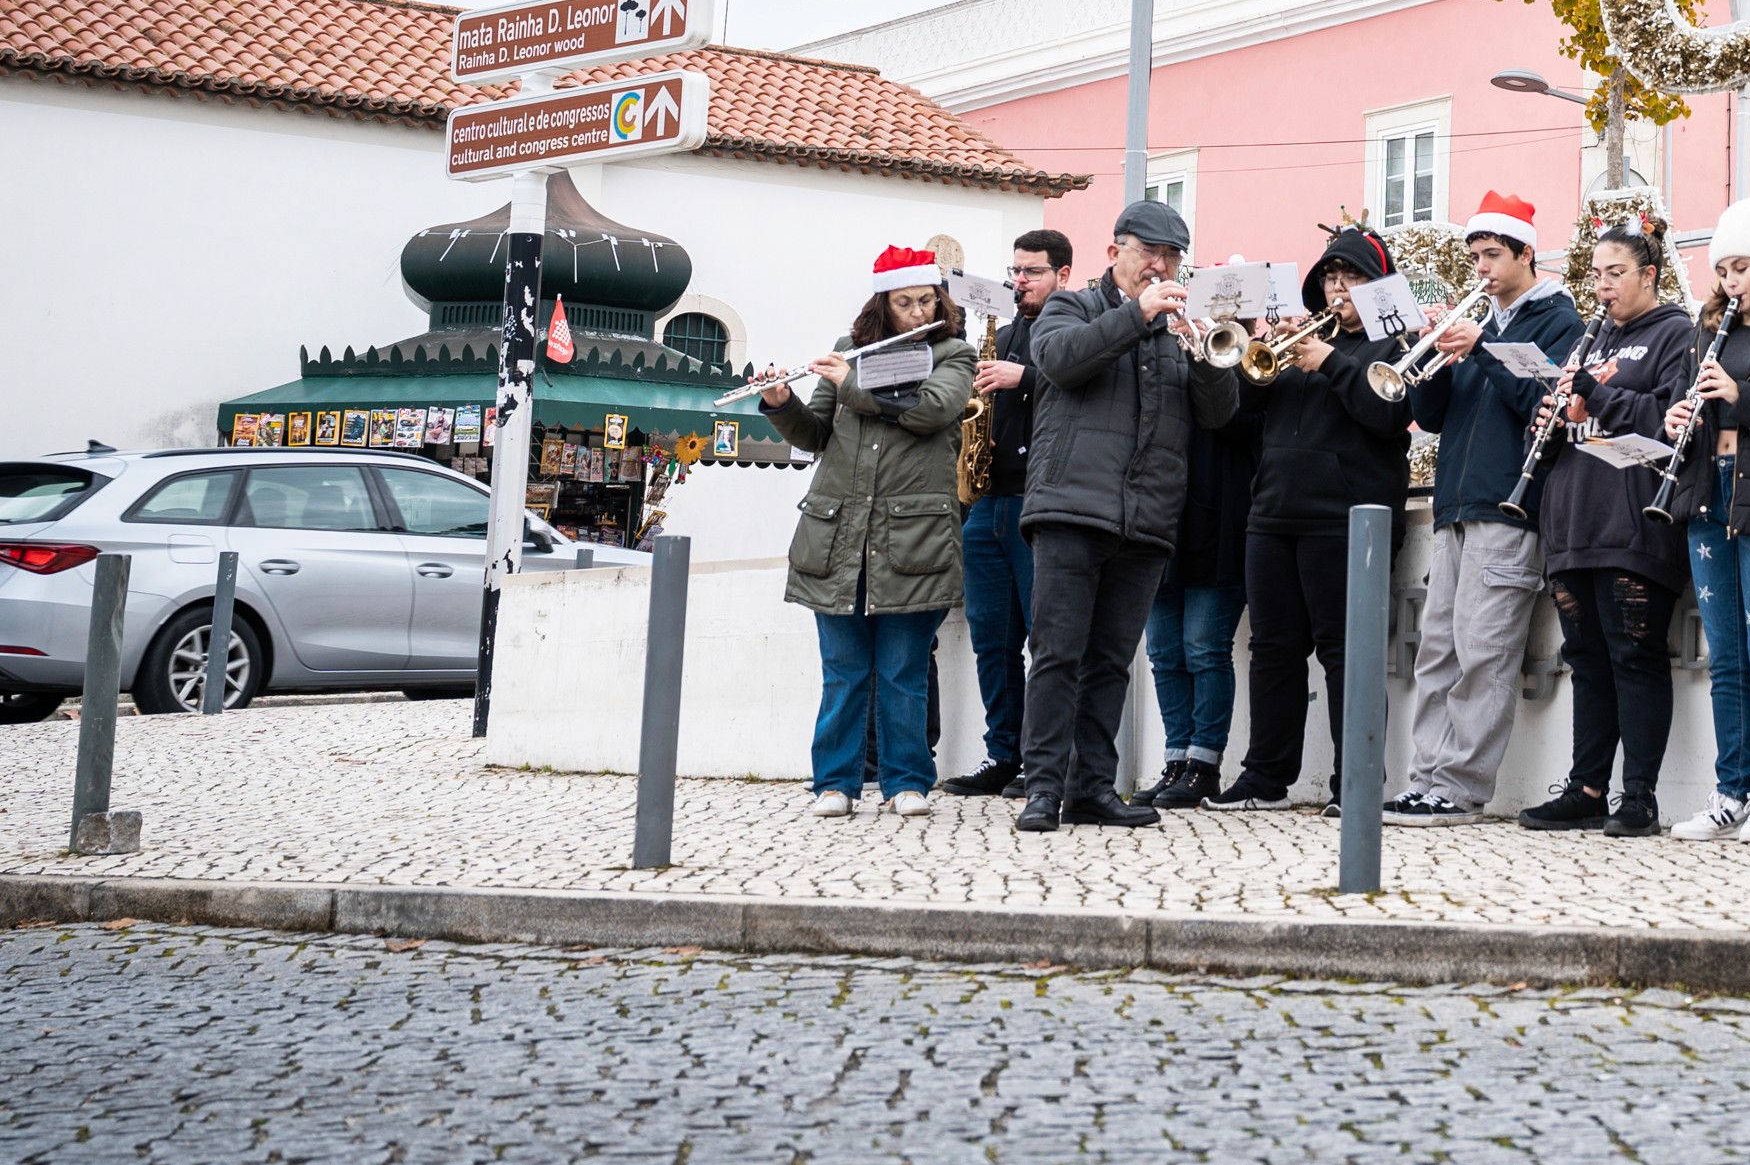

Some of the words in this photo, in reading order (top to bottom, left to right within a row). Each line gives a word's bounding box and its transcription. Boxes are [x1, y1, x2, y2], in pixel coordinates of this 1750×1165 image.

[459, 26, 492, 50] mata
[497, 13, 543, 43] Rainha
[548, 9, 562, 33] D.
[567, 3, 615, 27] Leonor
[459, 47, 495, 70] Rainha
[499, 45, 510, 62] D.
[513, 39, 551, 61] Leonor
[554, 33, 585, 54] wood
[453, 122, 486, 144] centro
[487, 109, 528, 138] cultural
[528, 116, 535, 131] e
[536, 110, 549, 129] de
[551, 102, 610, 131] congressos
[452, 142, 494, 165] cultural
[496, 138, 517, 158] and
[519, 136, 569, 159] congress
[571, 130, 608, 146] centre
